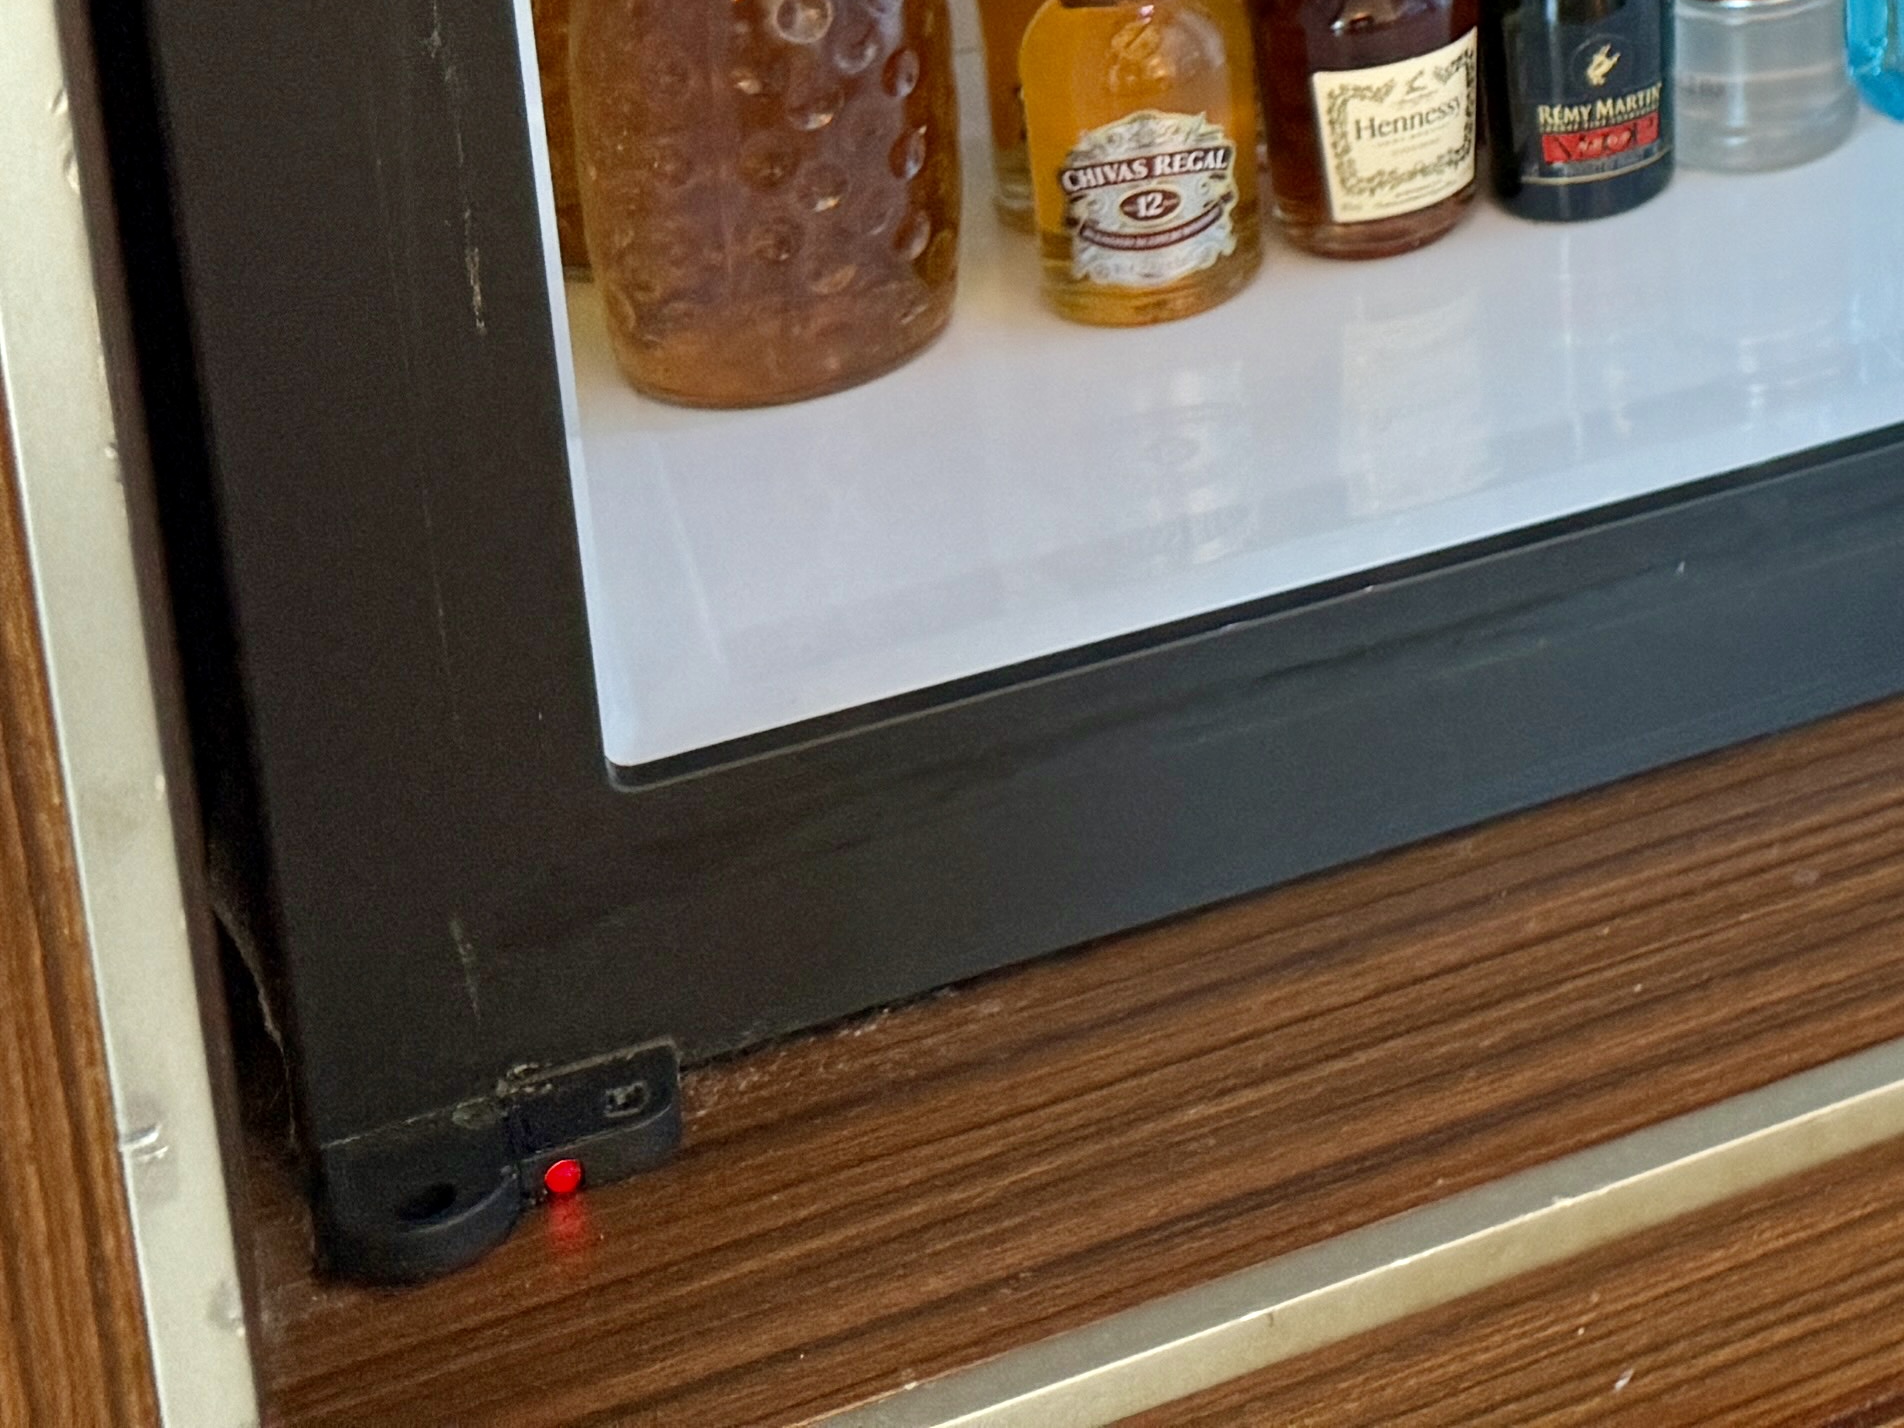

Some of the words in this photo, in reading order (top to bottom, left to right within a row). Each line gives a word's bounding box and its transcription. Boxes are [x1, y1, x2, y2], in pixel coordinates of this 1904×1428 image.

[1354, 96, 1461, 141] Hennessy
[1062, 158, 1149, 192] CHIVAS
[1153, 148, 1230, 176] REGAL
[1136, 192, 1165, 219] 12
